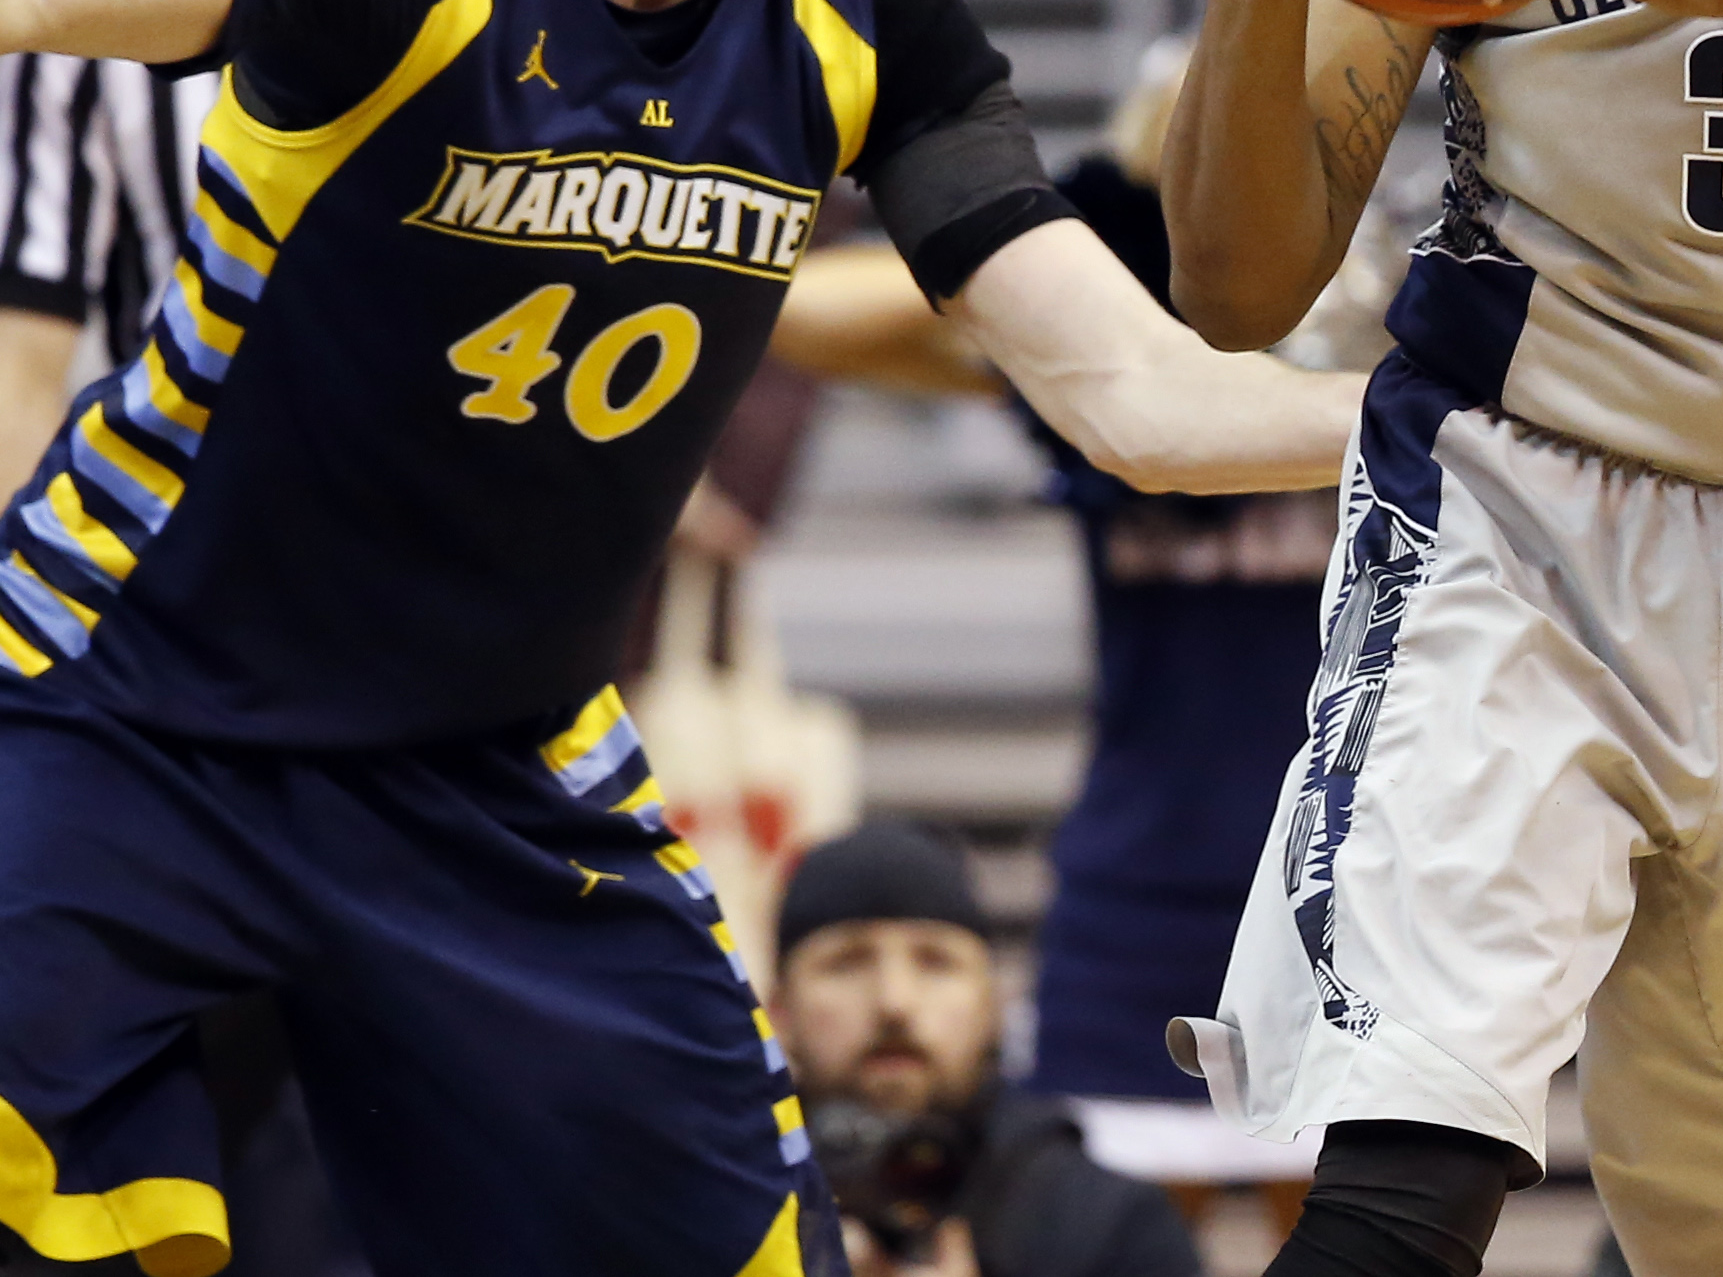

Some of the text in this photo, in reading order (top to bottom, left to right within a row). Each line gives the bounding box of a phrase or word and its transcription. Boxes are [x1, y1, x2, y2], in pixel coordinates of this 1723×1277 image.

[640, 99, 674, 128] AL
[434, 161, 812, 268] MARQUETTE
[447, 282, 702, 443] 40
